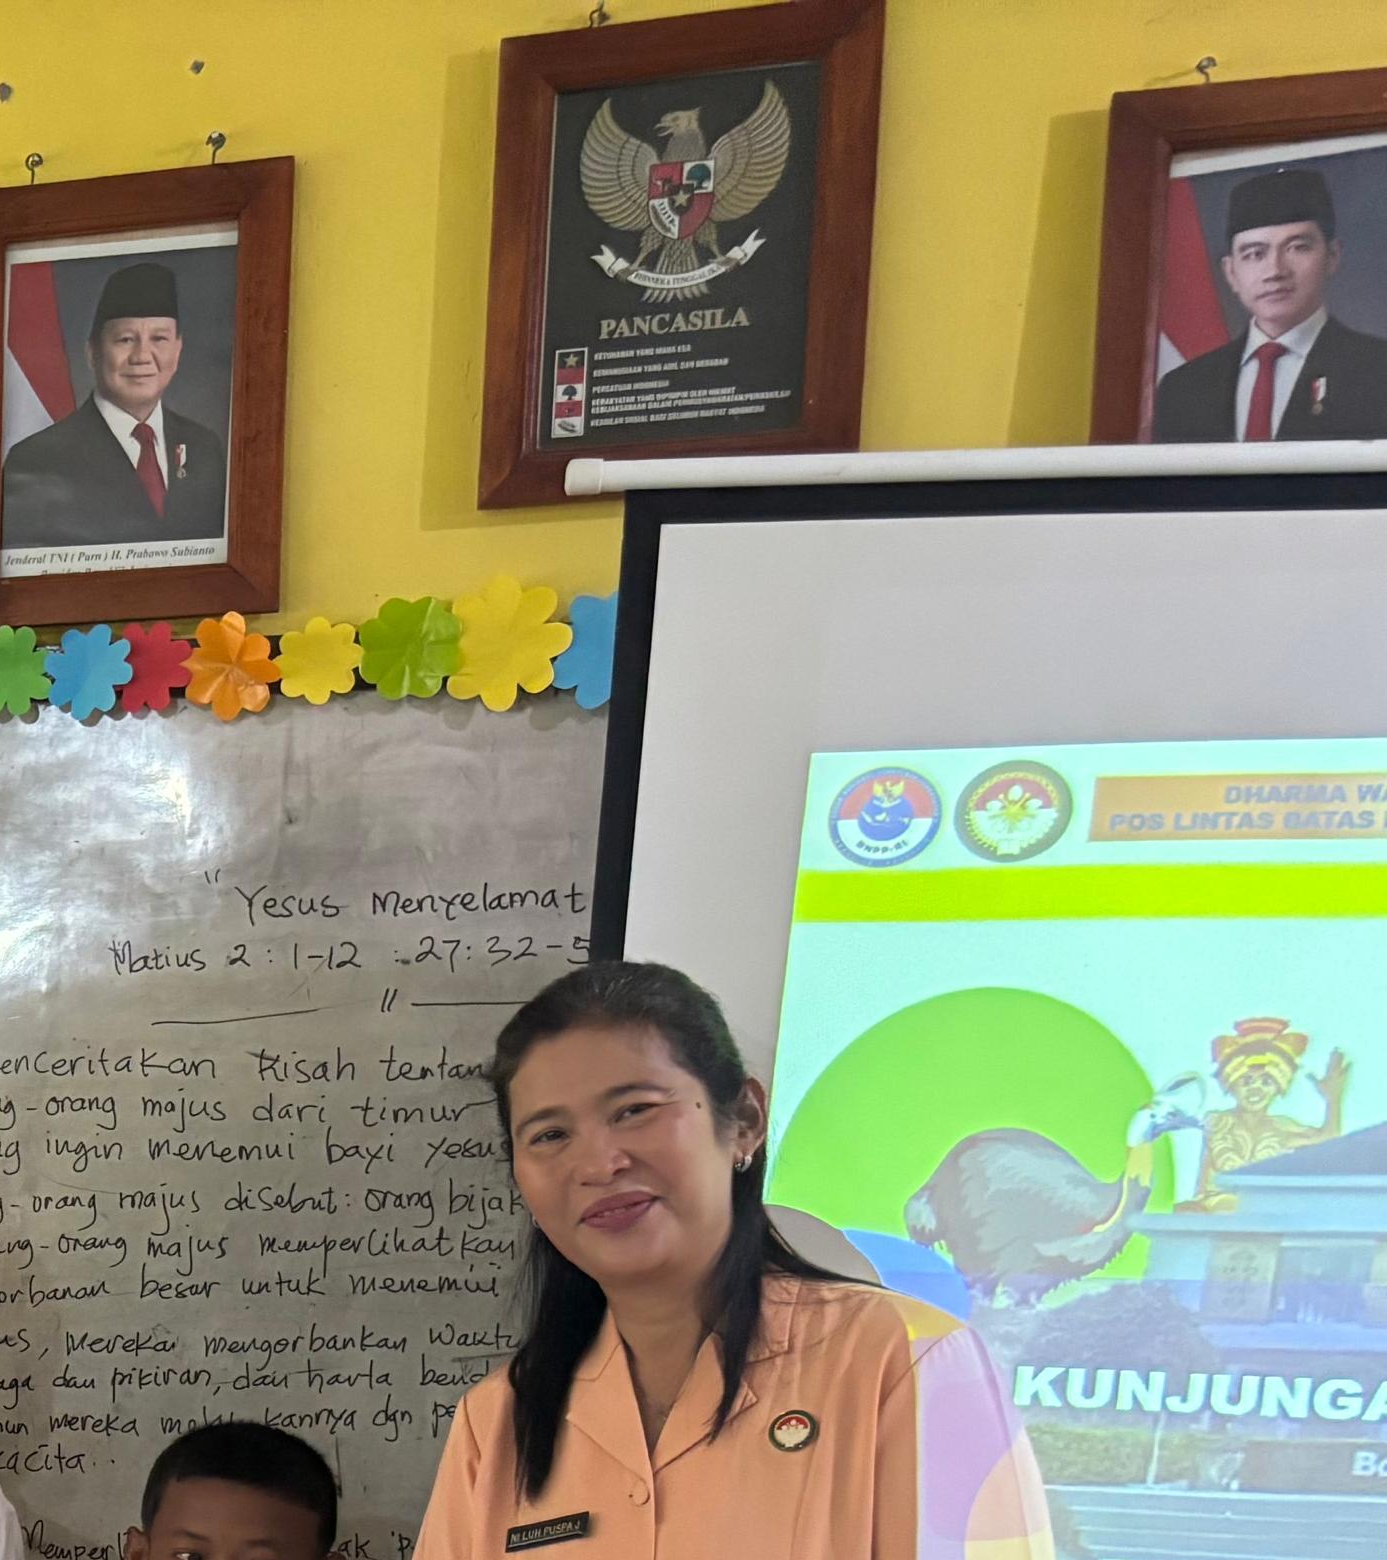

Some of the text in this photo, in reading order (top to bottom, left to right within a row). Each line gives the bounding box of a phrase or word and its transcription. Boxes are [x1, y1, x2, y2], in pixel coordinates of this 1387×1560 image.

[599, 307, 751, 339] PANCASILA
[170, 545, 215, 558] Subianto
[1223, 784, 1347, 804] DHARMA
[1109, 813, 1164, 832] POS
[1173, 811, 1274, 831] LINTAS
[1283, 810, 1375, 830] BATAS
[235, 884, 343, 926] Yesus
[141, 1088, 227, 1133] majus
[252, 1093, 326, 1123] dari
[119, 1184, 200, 1236] majus
[147, 1223, 229, 1277] majus
[241, 1267, 326, 1297] untuk
